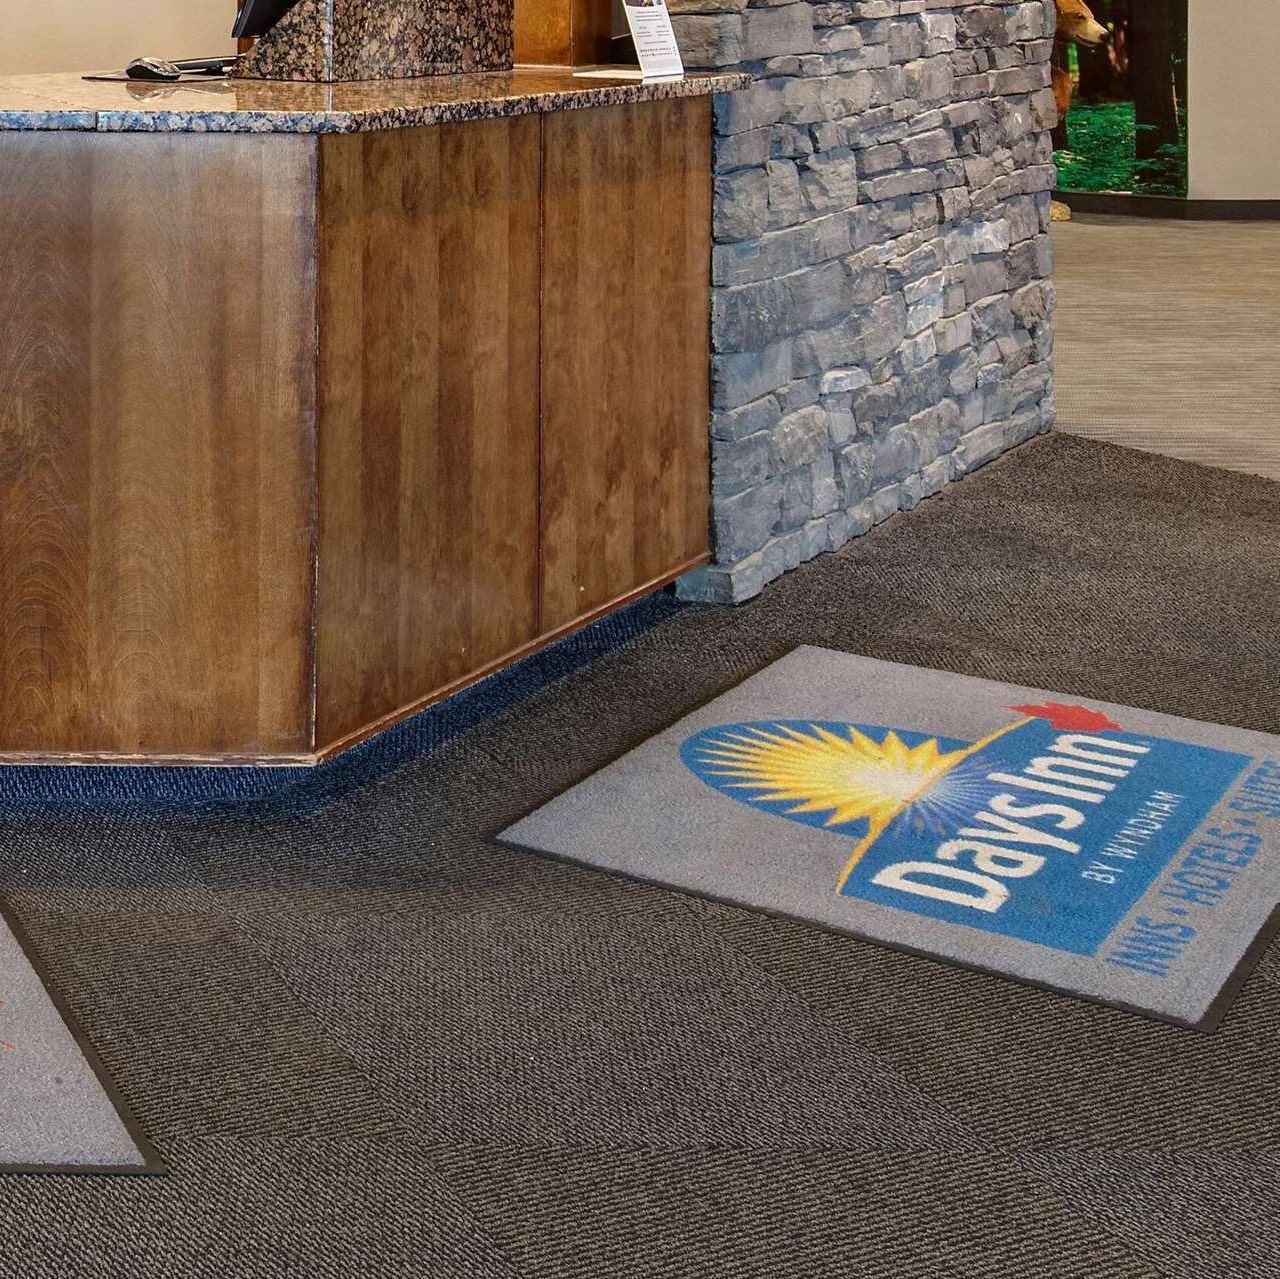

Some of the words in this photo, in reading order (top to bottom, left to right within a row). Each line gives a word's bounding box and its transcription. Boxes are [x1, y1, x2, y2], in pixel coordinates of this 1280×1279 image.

[872, 793, 1086, 913] Days
[986, 734, 1151, 804] Inn
[1081, 860, 1124, 885] BY
[1101, 789, 1186, 860] WYNDHAM
[1102, 915, 1199, 978] INNS
[1160, 827, 1266, 908] HOTELS
